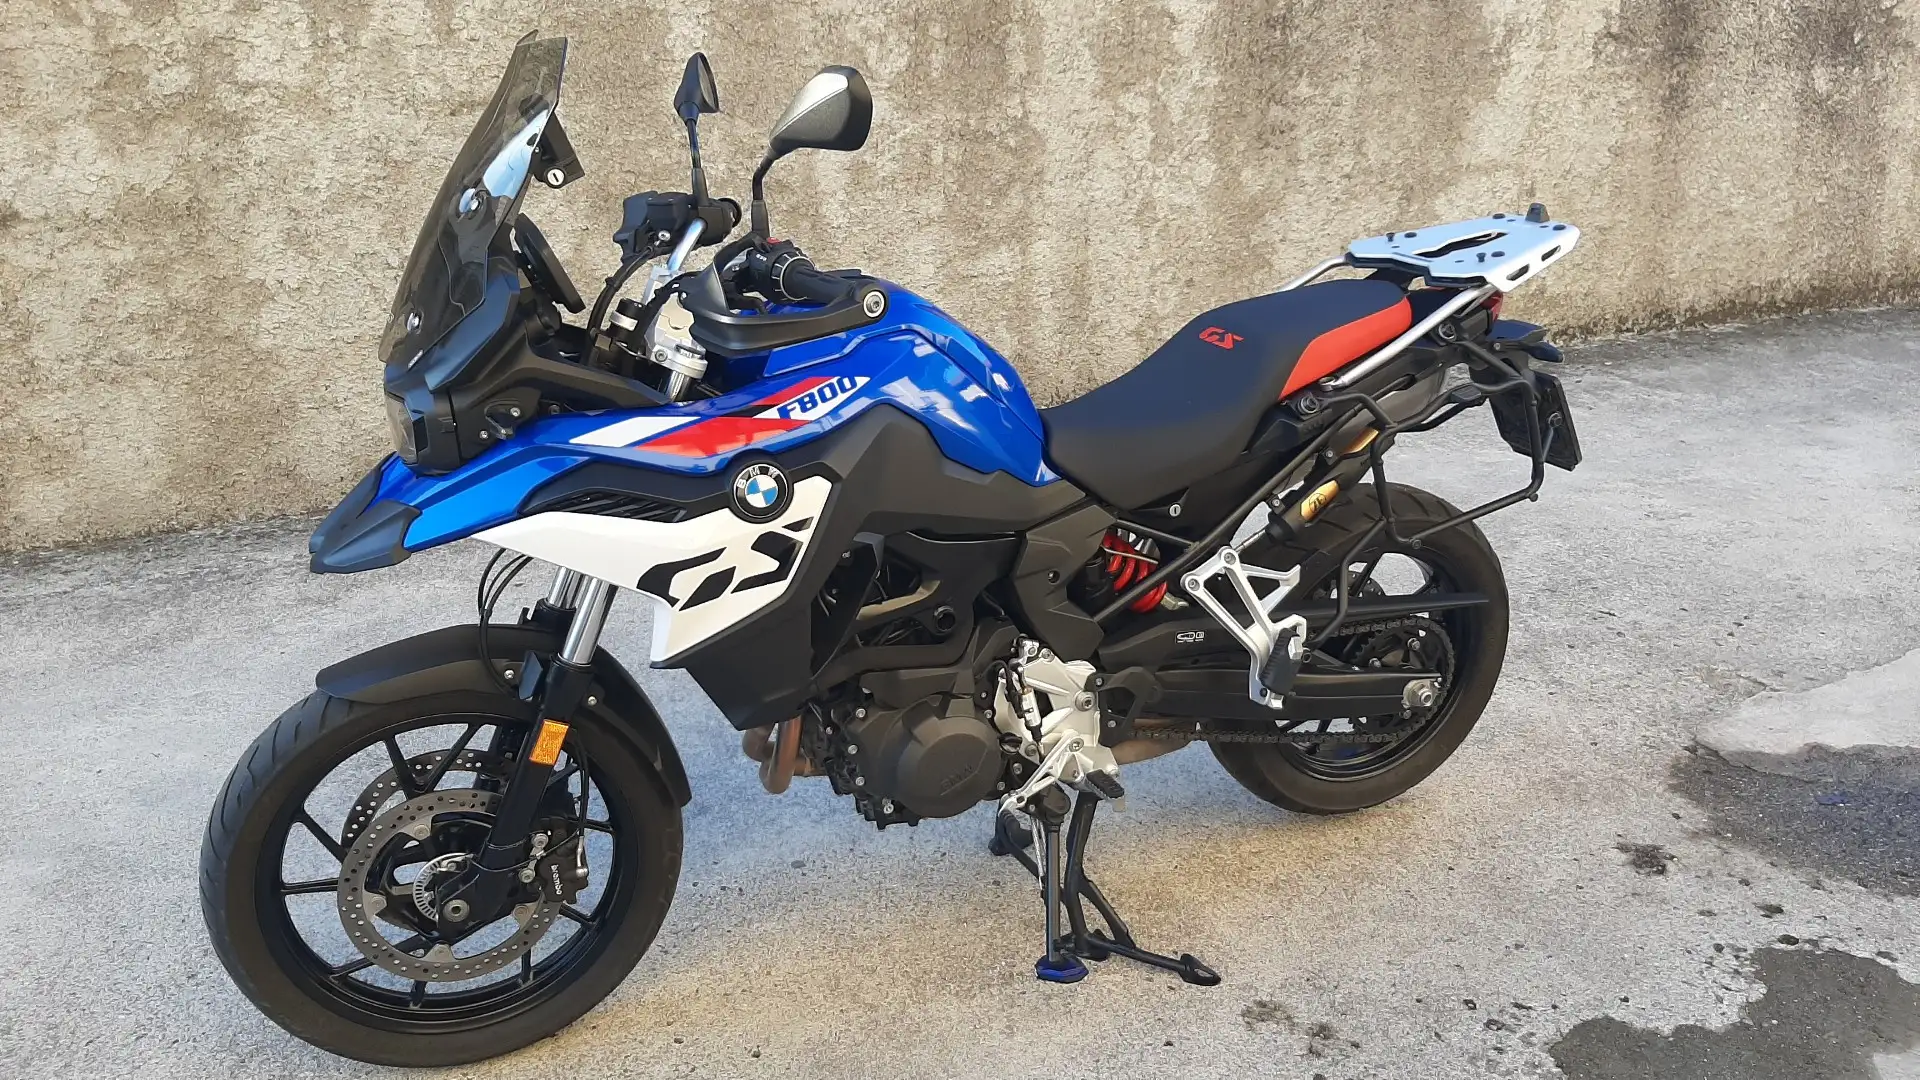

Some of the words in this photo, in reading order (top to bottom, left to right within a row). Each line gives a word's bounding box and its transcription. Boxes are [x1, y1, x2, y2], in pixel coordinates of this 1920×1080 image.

[1199, 326, 1244, 349] GS
[777, 375, 857, 419] F800
[736, 465, 780, 489] BMW
[550, 864, 563, 895] brembo
